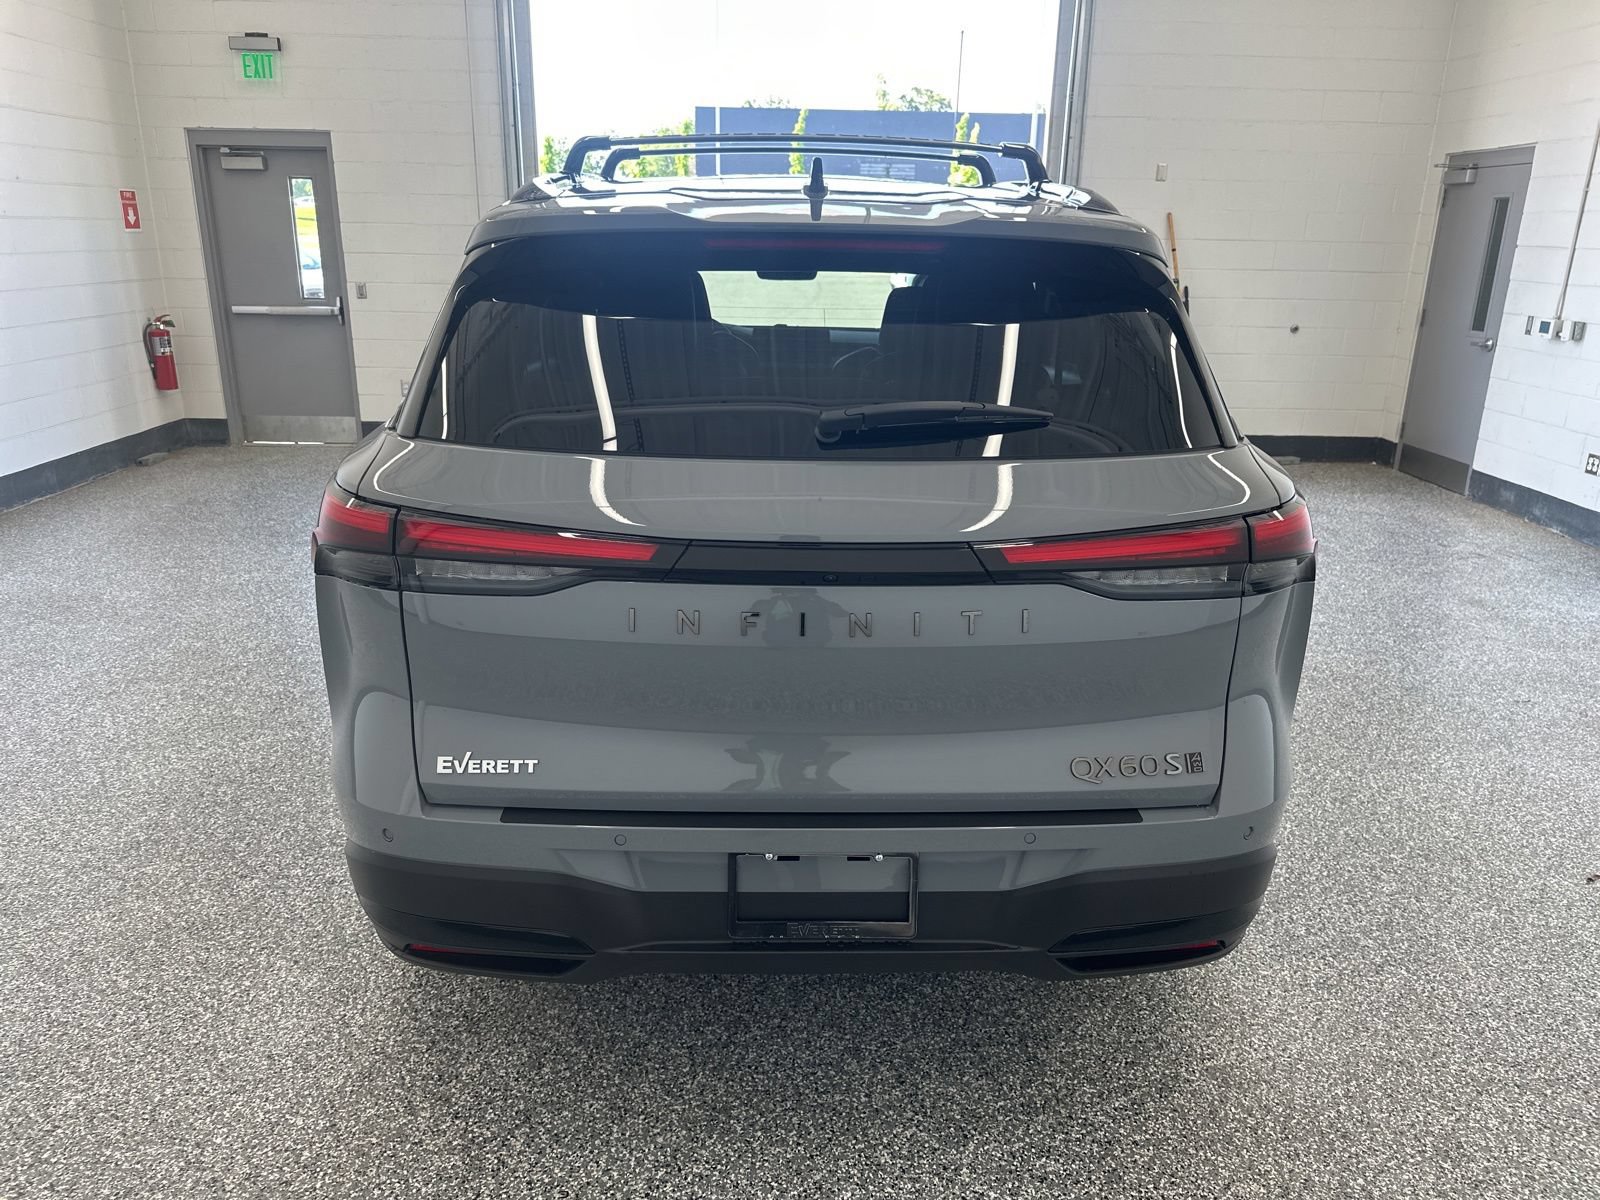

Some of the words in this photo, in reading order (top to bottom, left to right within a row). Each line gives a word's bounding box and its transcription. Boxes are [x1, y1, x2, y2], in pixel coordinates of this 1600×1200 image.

[241, 53, 273, 79] EXIT
[627, 606, 1031, 638] INFINITI
[436, 751, 539, 774] EVERETT
